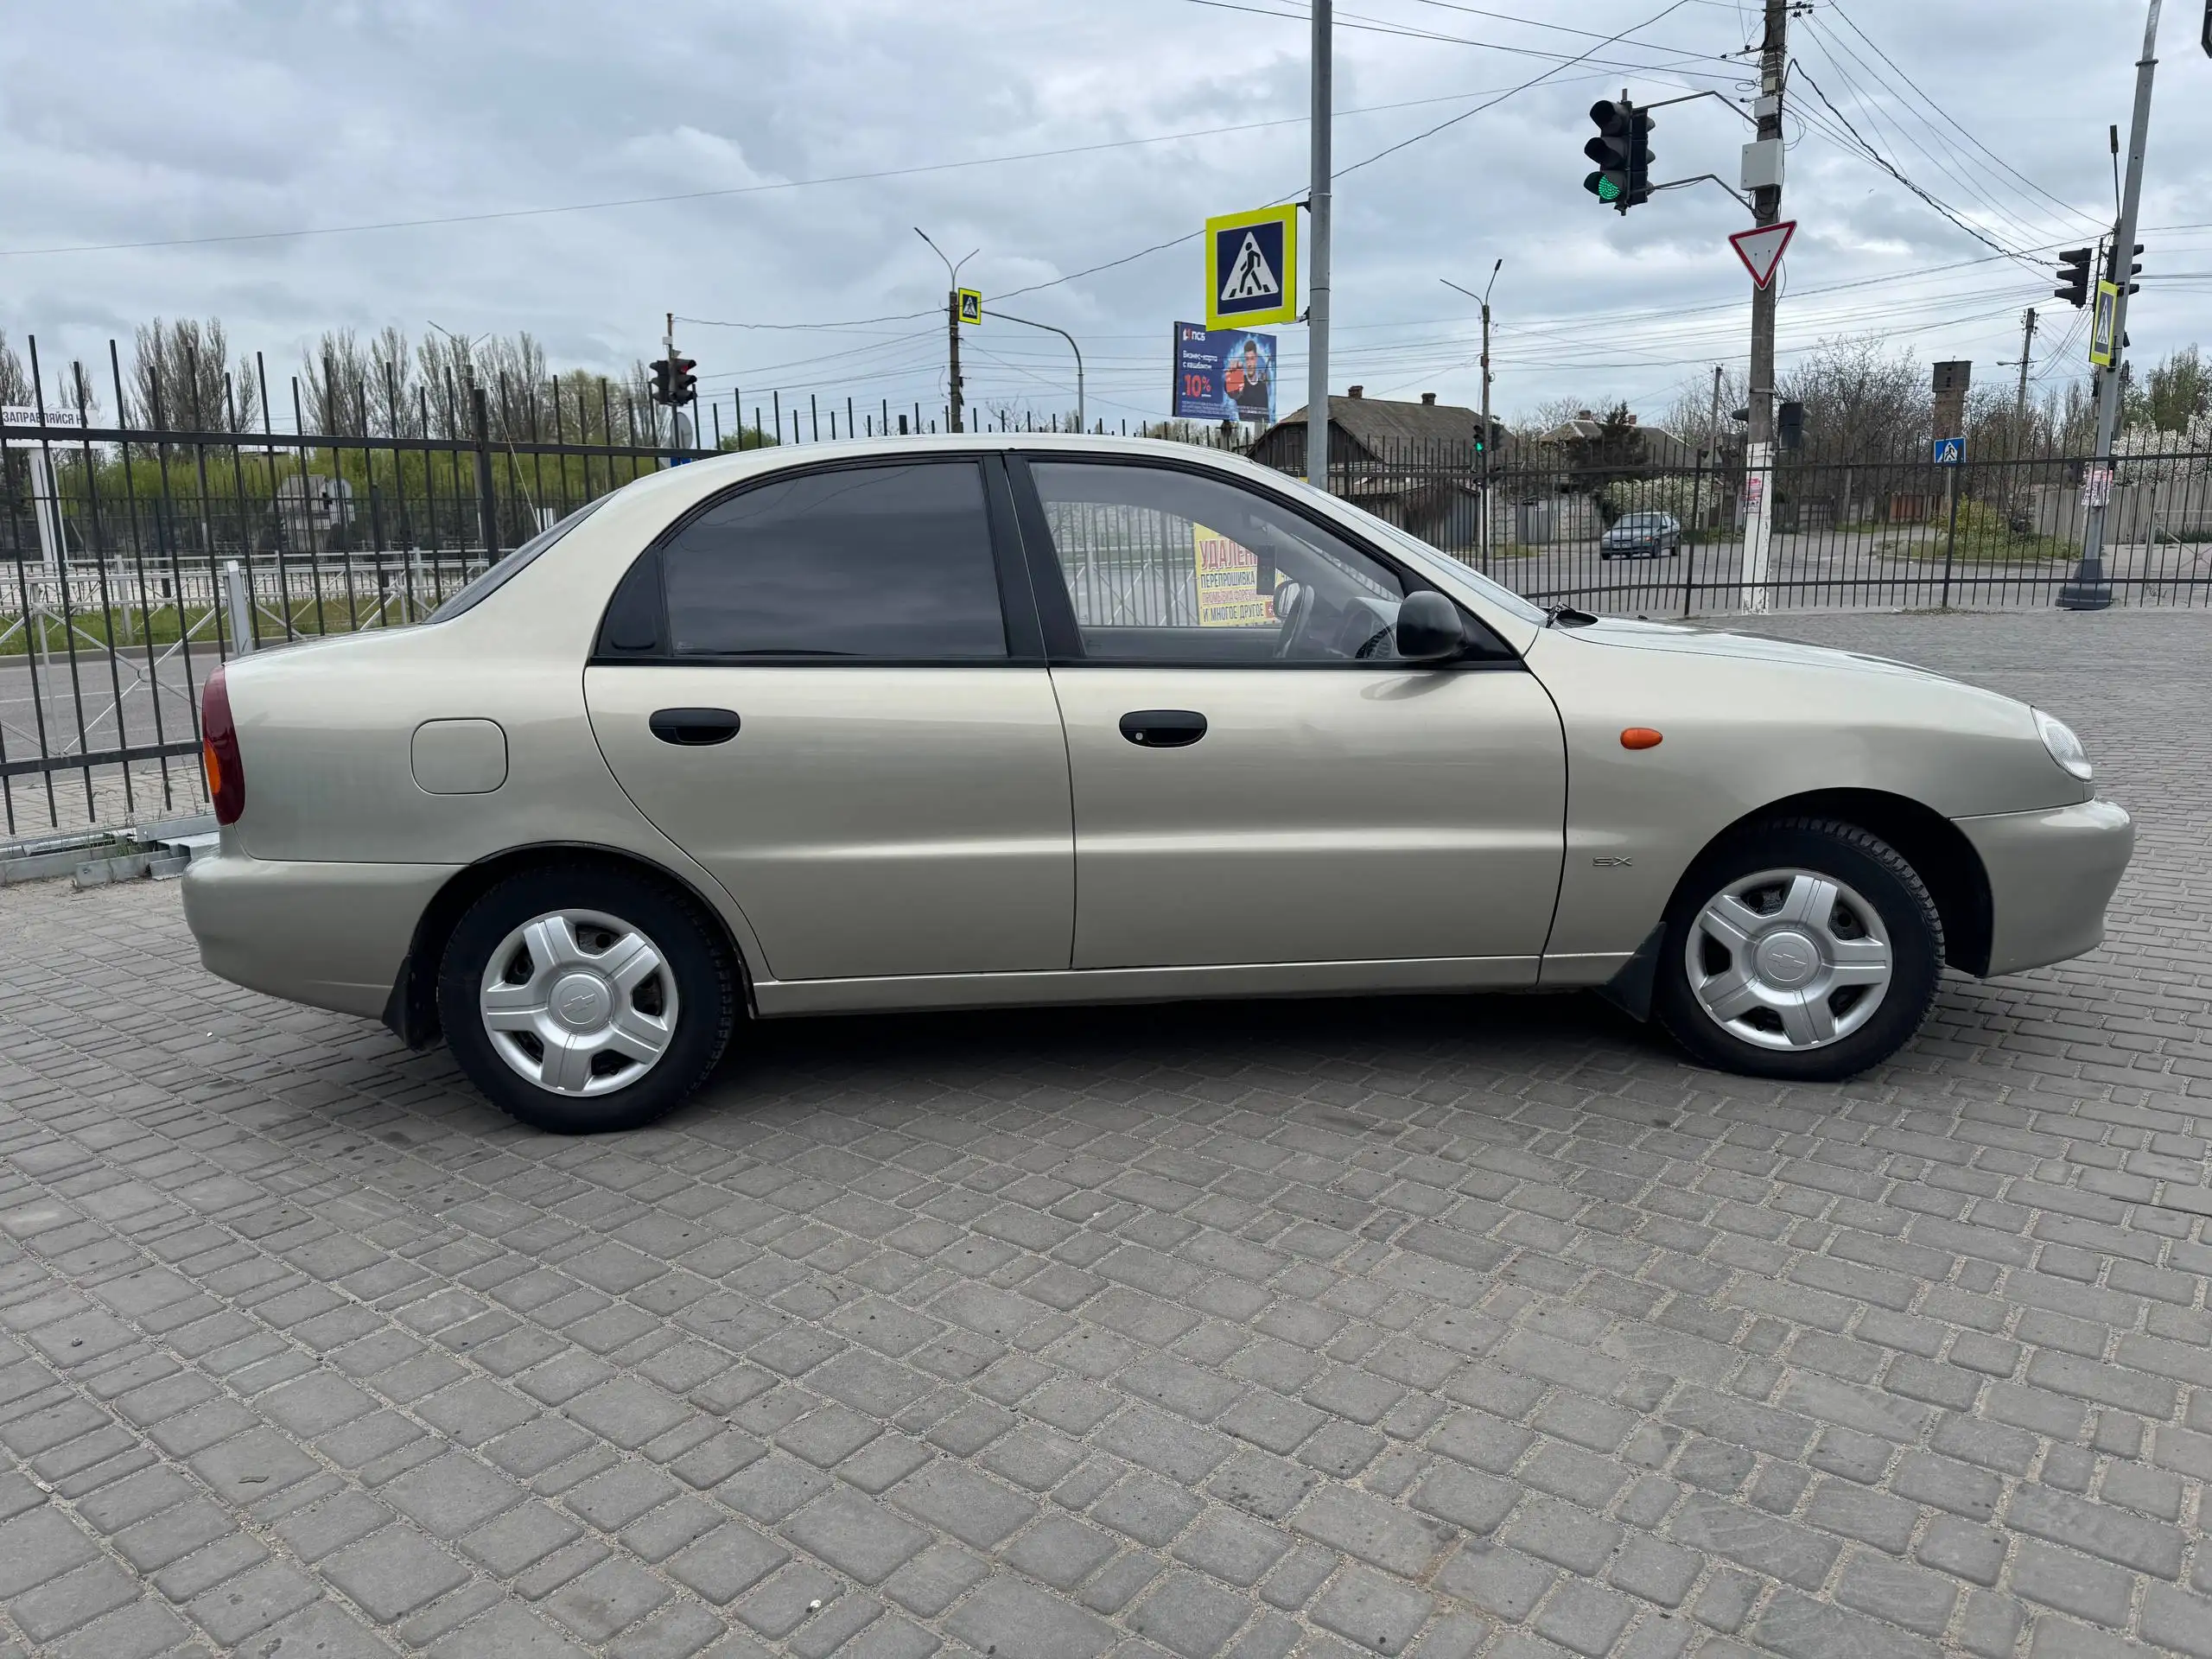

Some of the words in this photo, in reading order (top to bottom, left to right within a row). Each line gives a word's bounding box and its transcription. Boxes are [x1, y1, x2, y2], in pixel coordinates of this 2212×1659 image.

[1192, 331, 1205, 341] ПСБ
[1185, 374, 1211, 397] 10%
[1201, 571, 1255, 588] ПЕРЕПРОШИВКА
[1204, 607, 1209, 622] И
[1211, 605, 1237, 621] МНОГОЕ
[1239, 603, 1264, 620] ДРУГОЕ
